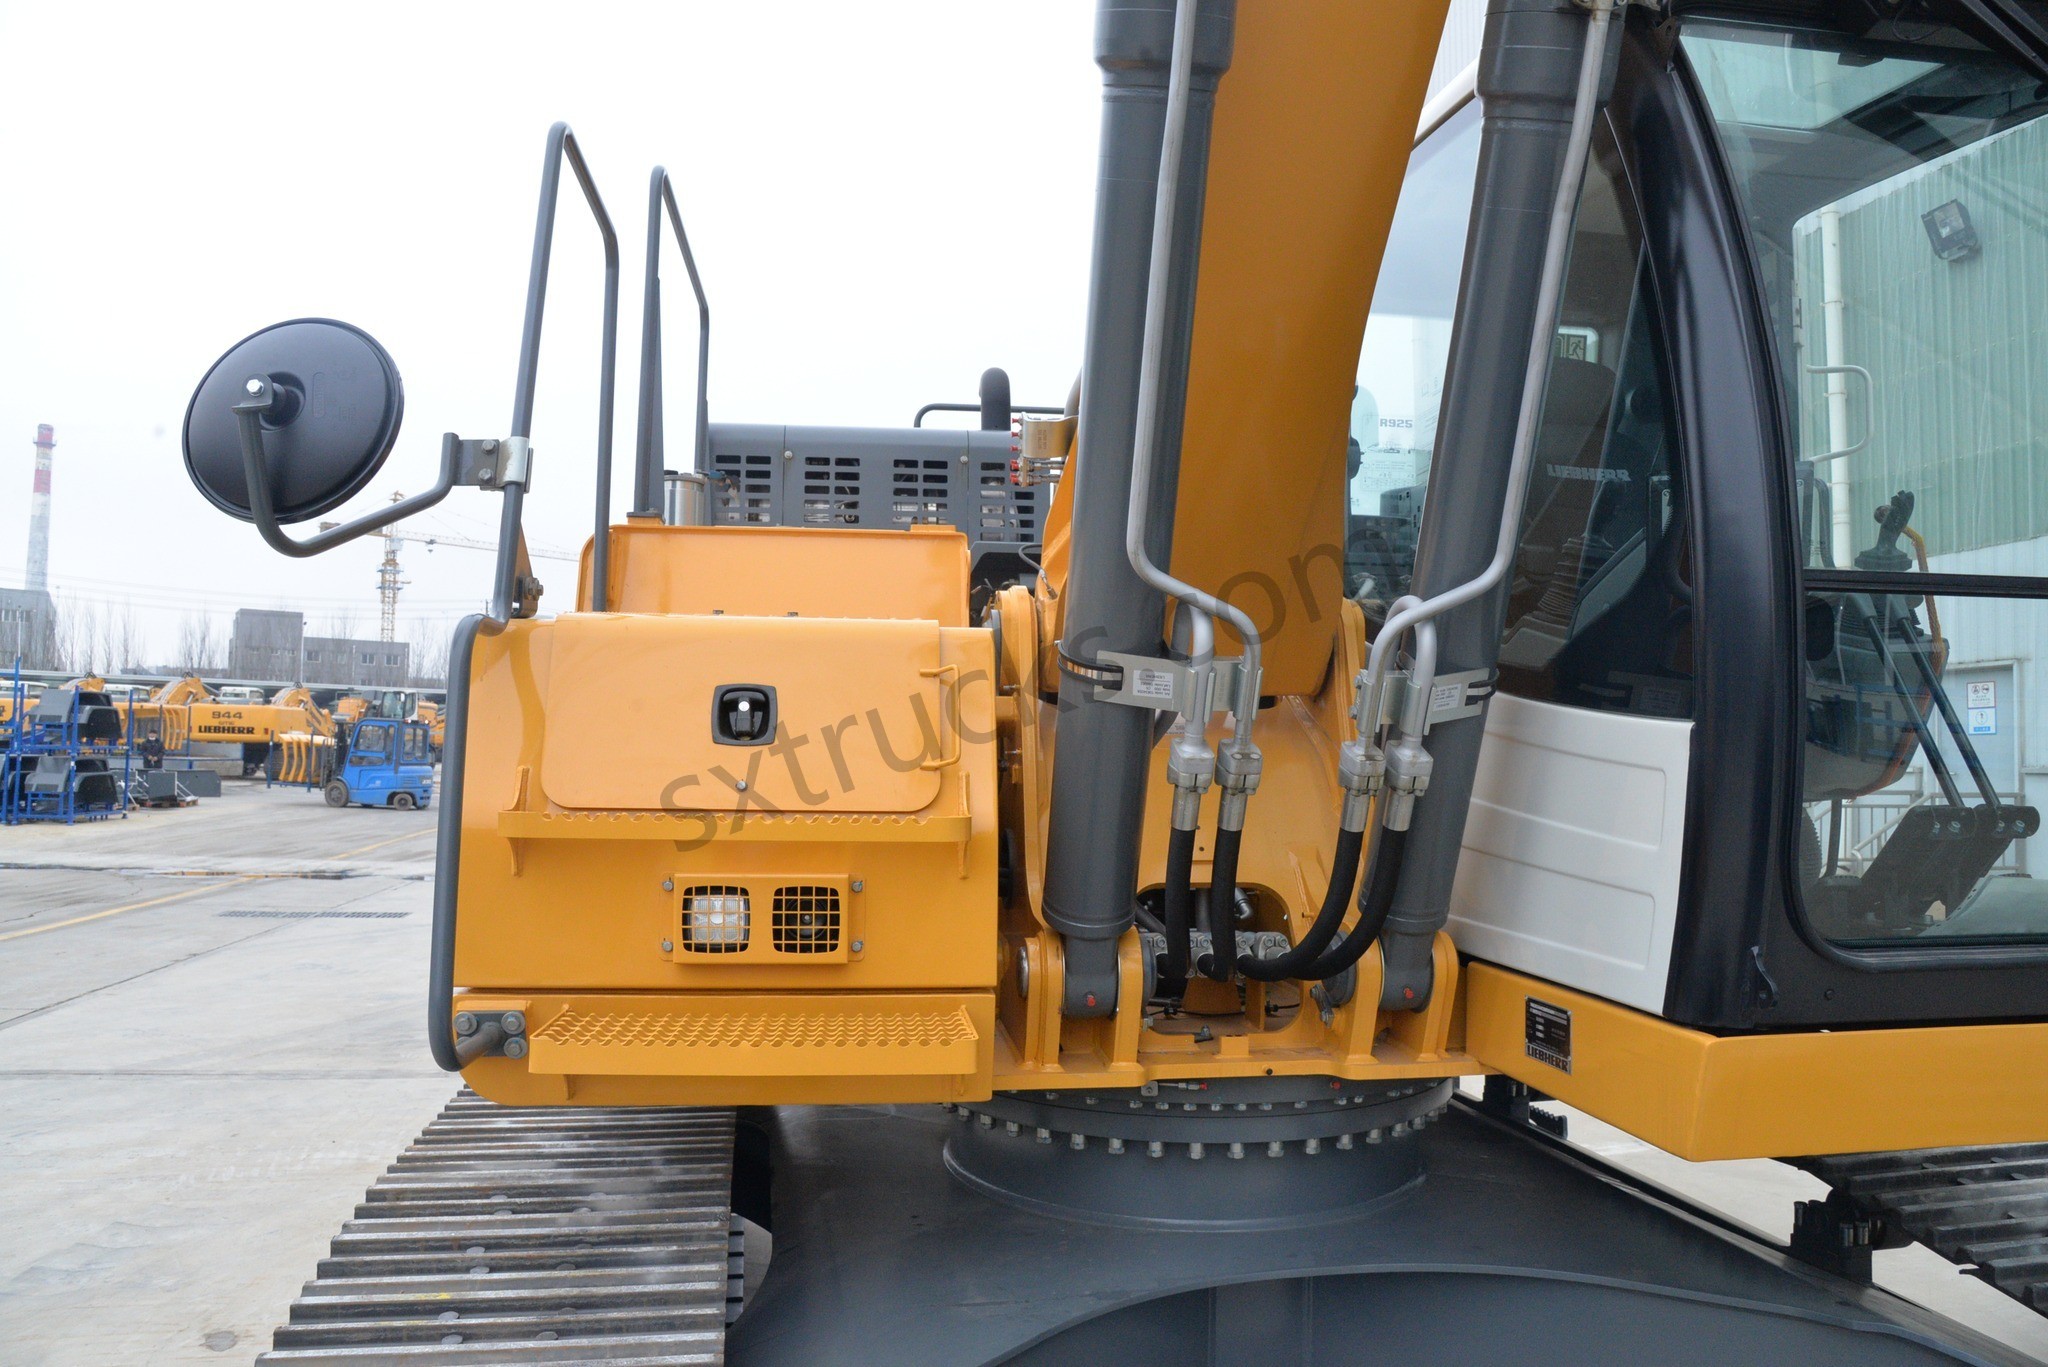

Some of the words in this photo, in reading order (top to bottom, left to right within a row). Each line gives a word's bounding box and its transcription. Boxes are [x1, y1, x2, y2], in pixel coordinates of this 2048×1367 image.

[1379, 418, 1413, 428] R925
[1546, 463, 1632, 482] LIEBHERR
[211, 711, 242, 719] 944
[198, 725, 255, 734] LIEBHERR
[1527, 1044, 1568, 1072] LIEBHERR
